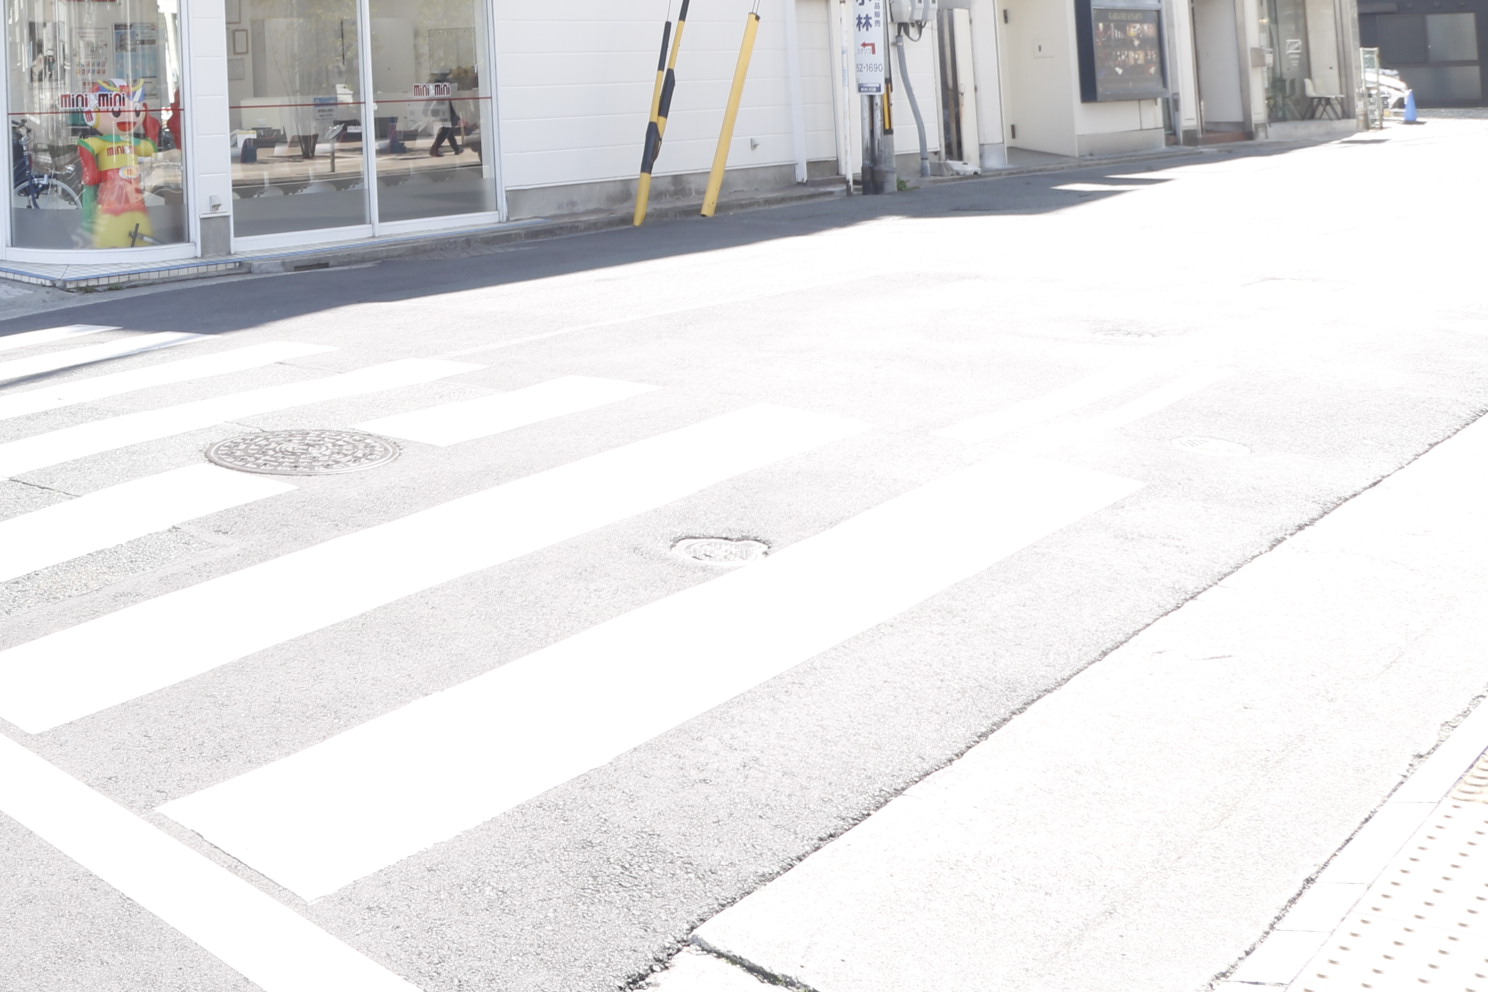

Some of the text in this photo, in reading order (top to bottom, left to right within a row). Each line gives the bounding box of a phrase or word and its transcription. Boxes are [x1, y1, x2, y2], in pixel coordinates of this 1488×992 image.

[414, 83, 450, 97] mini mini
[61, 93, 125, 108] mini mini
